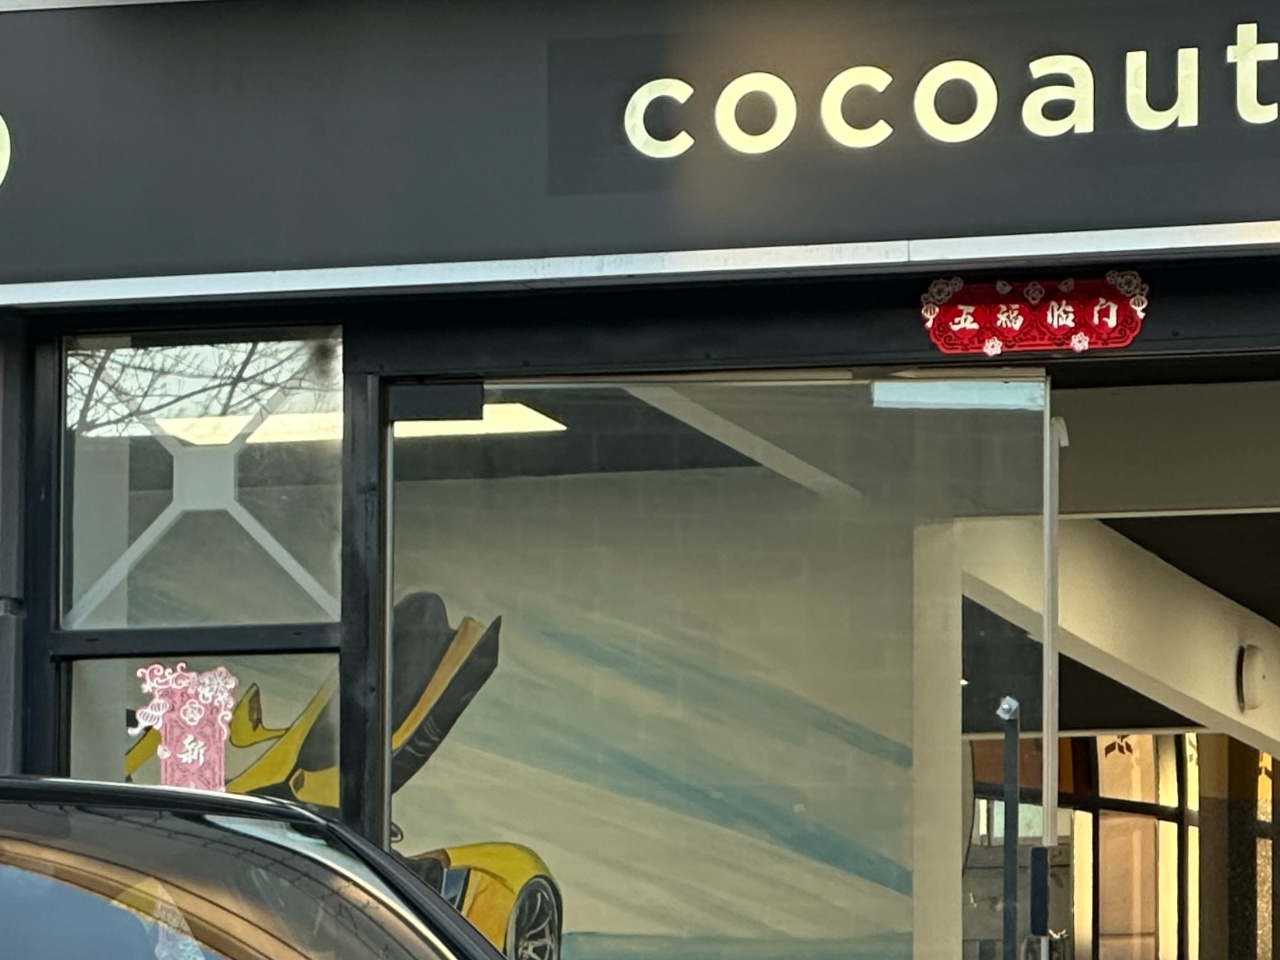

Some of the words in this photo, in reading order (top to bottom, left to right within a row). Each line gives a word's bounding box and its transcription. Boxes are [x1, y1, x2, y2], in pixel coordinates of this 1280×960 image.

[624, 23, 1279, 158] cocoaut
[949, 298, 1118, 331] 五福临门
